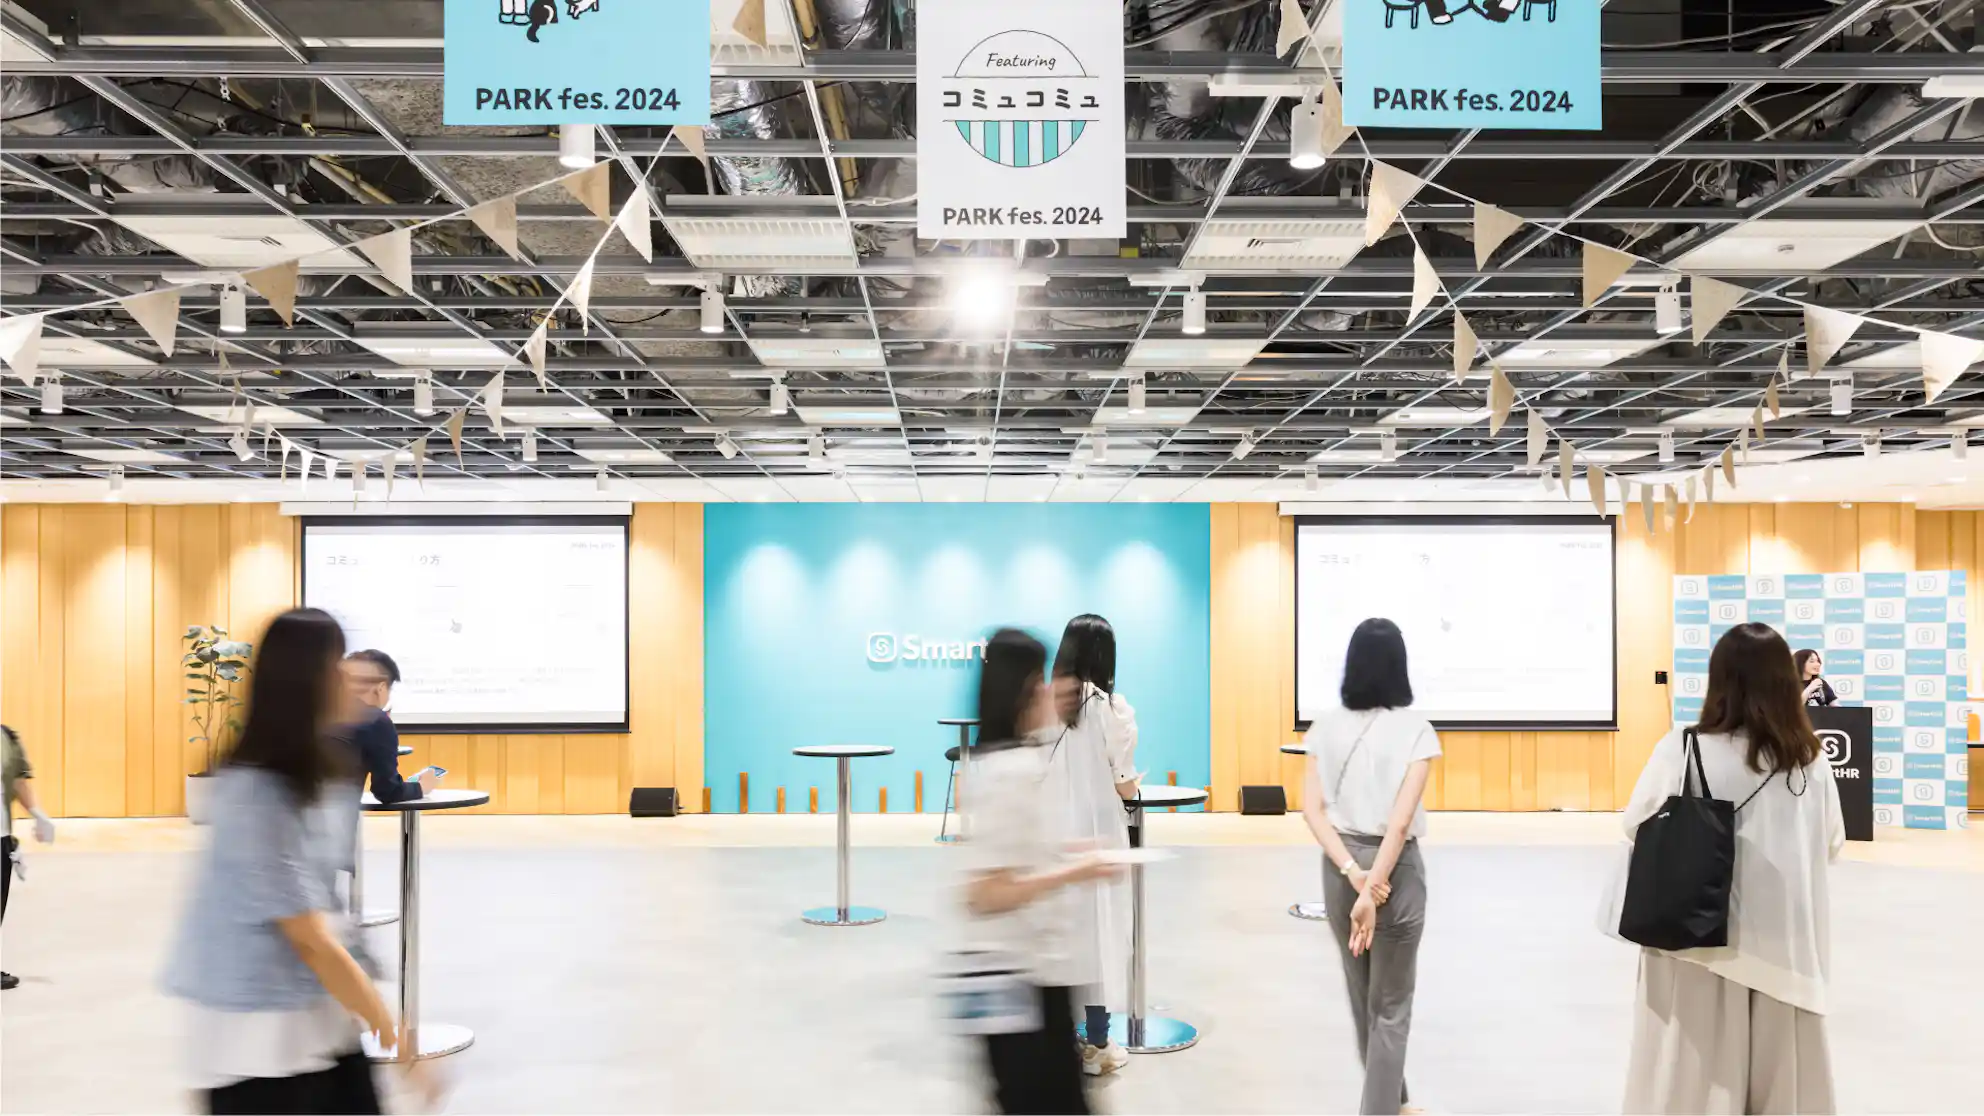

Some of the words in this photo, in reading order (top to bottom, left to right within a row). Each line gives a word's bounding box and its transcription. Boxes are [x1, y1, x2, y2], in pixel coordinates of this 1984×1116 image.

[986, 52, 1057, 70] Featuring
[476, 88, 552, 110] PARK
[558, 88, 608, 110] fes.
[615, 88, 681, 111] 2024
[943, 88, 1099, 109] コミュコミュ
[1373, 87, 1449, 110] PARK
[1453, 88, 1504, 111] fes.
[1509, 90, 1574, 113] 2024
[943, 207, 1004, 225] PARK
[1007, 206, 1047, 225] fes.
[1052, 207, 1103, 225] 2024
[902, 634, 988, 660] Smart
[1832, 767, 1860, 779] rtHR
